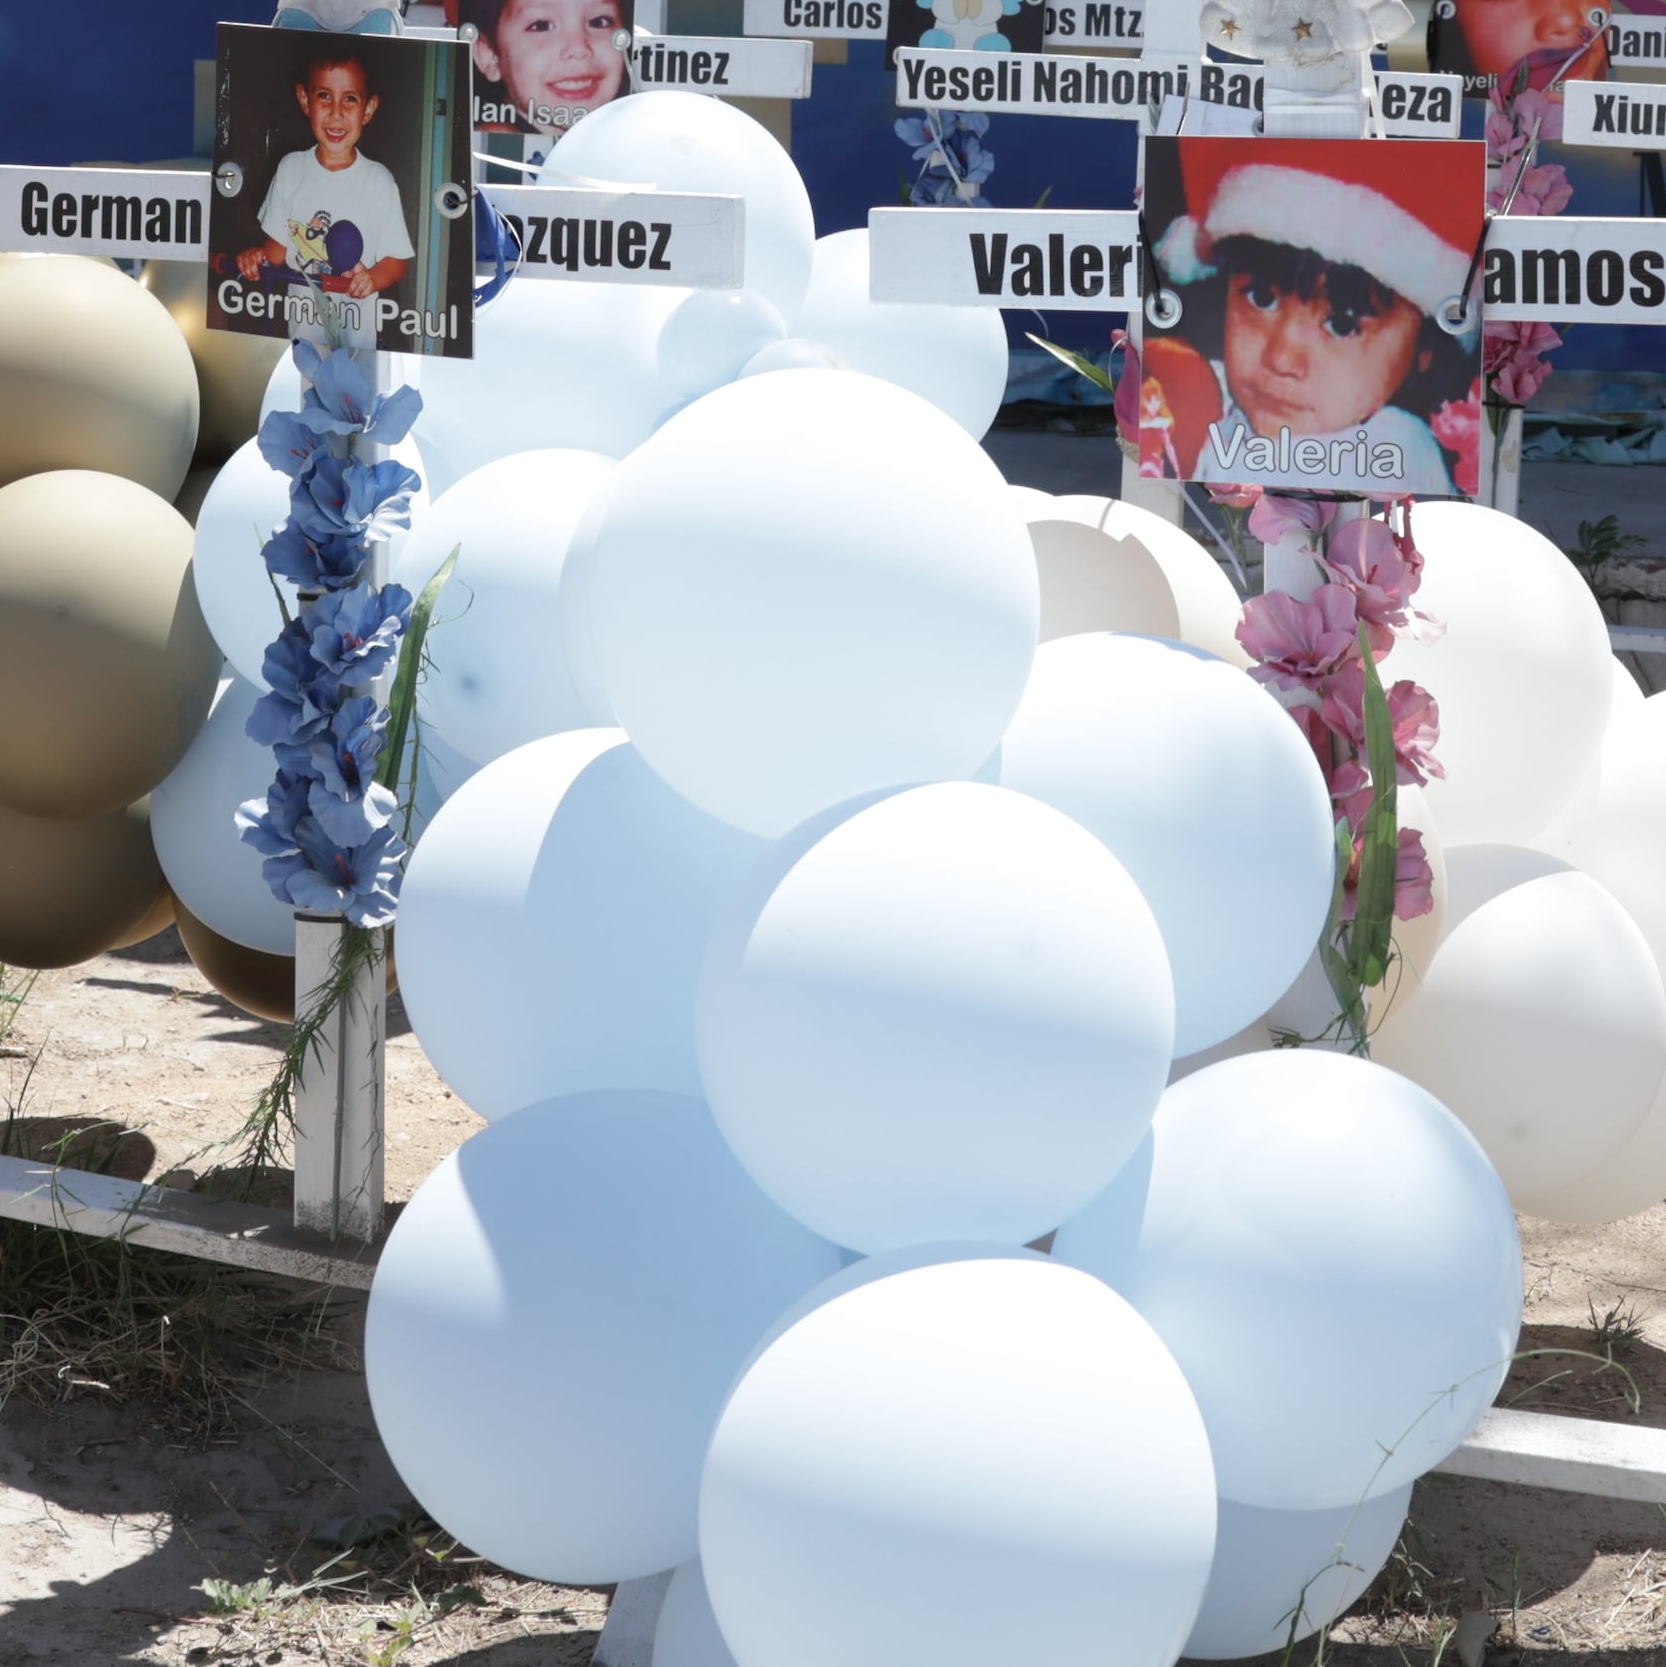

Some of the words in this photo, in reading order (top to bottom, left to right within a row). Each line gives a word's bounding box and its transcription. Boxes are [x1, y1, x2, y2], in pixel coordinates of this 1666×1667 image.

[633, 43, 730, 85] tinez
[903, 58, 1022, 102] Yeseli
[1033, 61, 1188, 108] Nahomi
[1370, 77, 1452, 122] eza
[528, 98, 589, 127] Isaa
[21, 181, 202, 245] German
[1485, 245, 1665, 307] amos
[374, 297, 458, 340] Paul
[1207, 421, 1405, 480] Valeria
